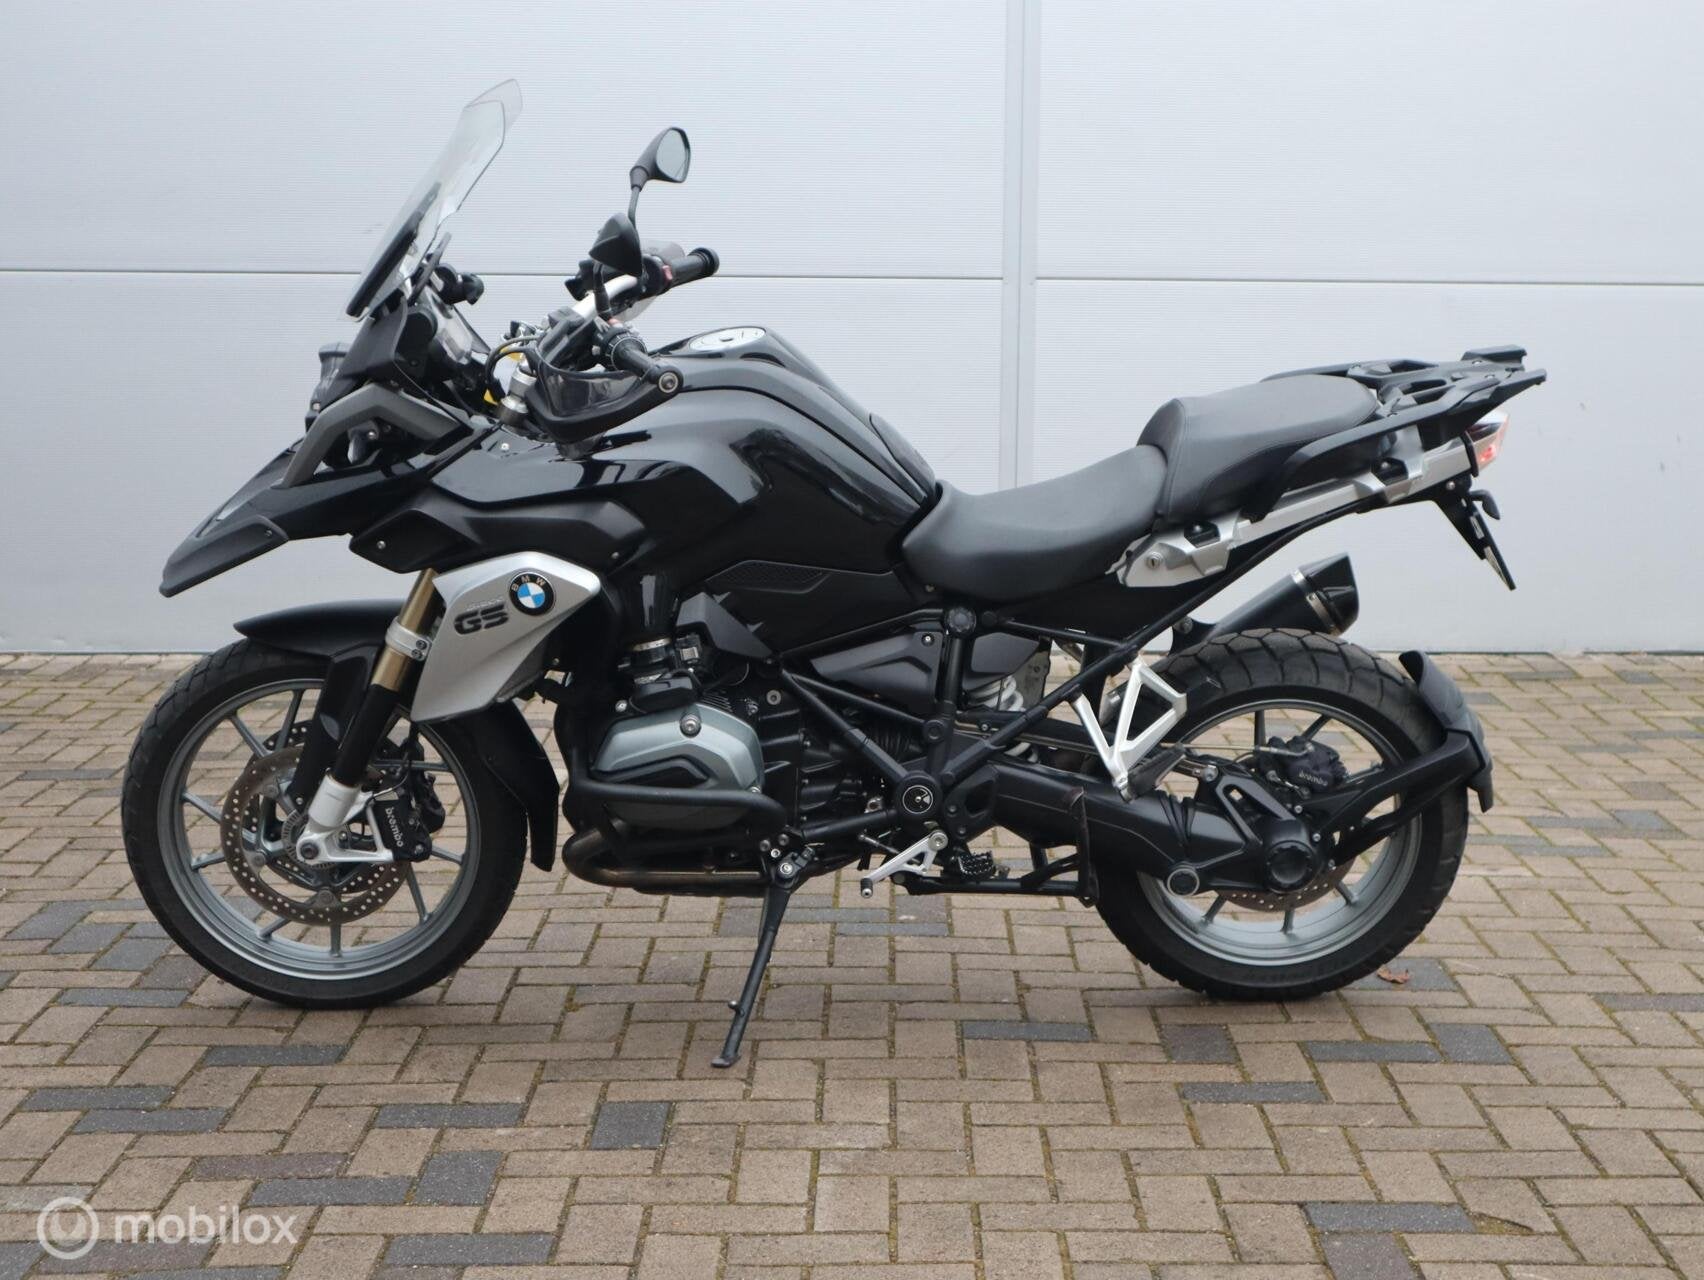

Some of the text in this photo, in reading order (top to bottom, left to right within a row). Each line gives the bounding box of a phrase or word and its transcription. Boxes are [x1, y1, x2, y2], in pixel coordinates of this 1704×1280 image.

[511, 574, 546, 592] BMW
[454, 603, 509, 635] GS
[385, 806, 404, 847] brembo
